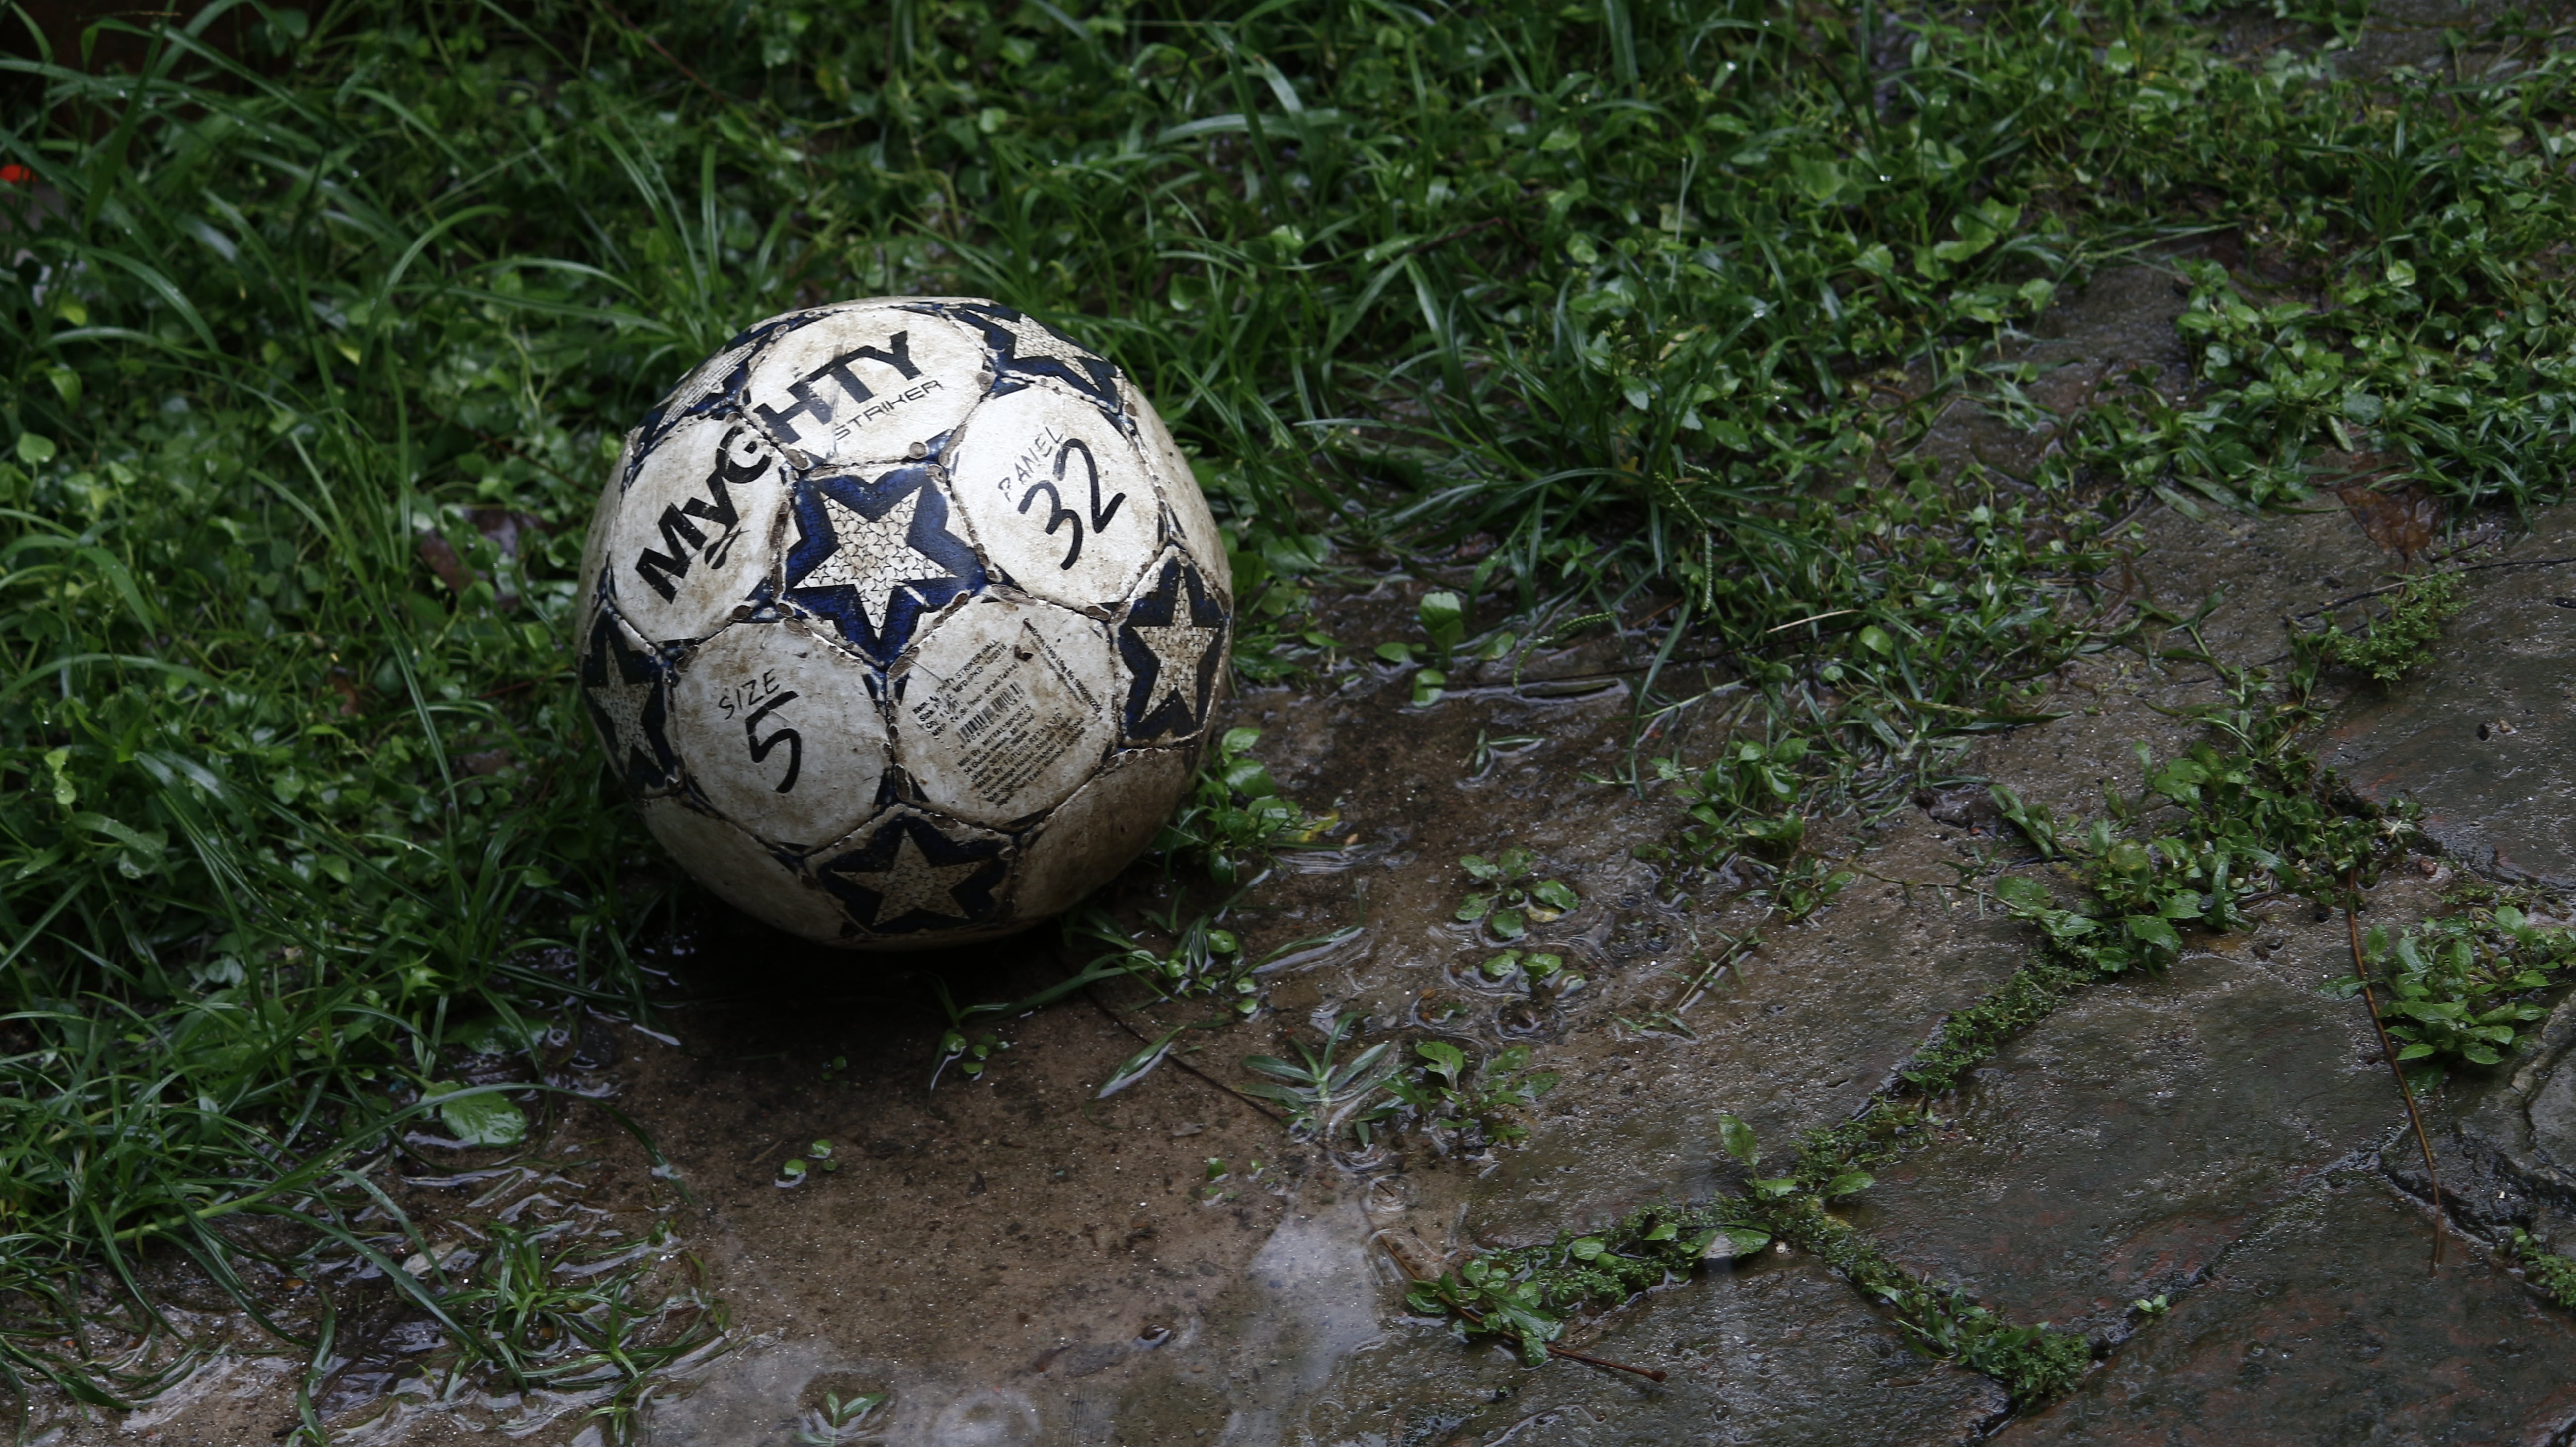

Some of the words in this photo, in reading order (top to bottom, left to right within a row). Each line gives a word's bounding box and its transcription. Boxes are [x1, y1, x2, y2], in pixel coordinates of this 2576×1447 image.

[835, 379, 943, 440] STRIKER
[998, 426, 1063, 503] PANEL
[1017, 438, 1127, 570] 32
[954, 653, 983, 679] STRIKER
[981, 638, 999, 654] BALL
[1044, 644, 1058, 659] Help
[719, 668, 780, 720] SIZE
[983, 685, 992, 694] of
[990, 678, 999, 688] all
[1017, 712, 1034, 728] Road
[1067, 716, 1084, 732] Road
[745, 691, 801, 793] 5
[1003, 742, 1030, 765] FUTURE
[982, 766, 1016, 796] Knowledge
